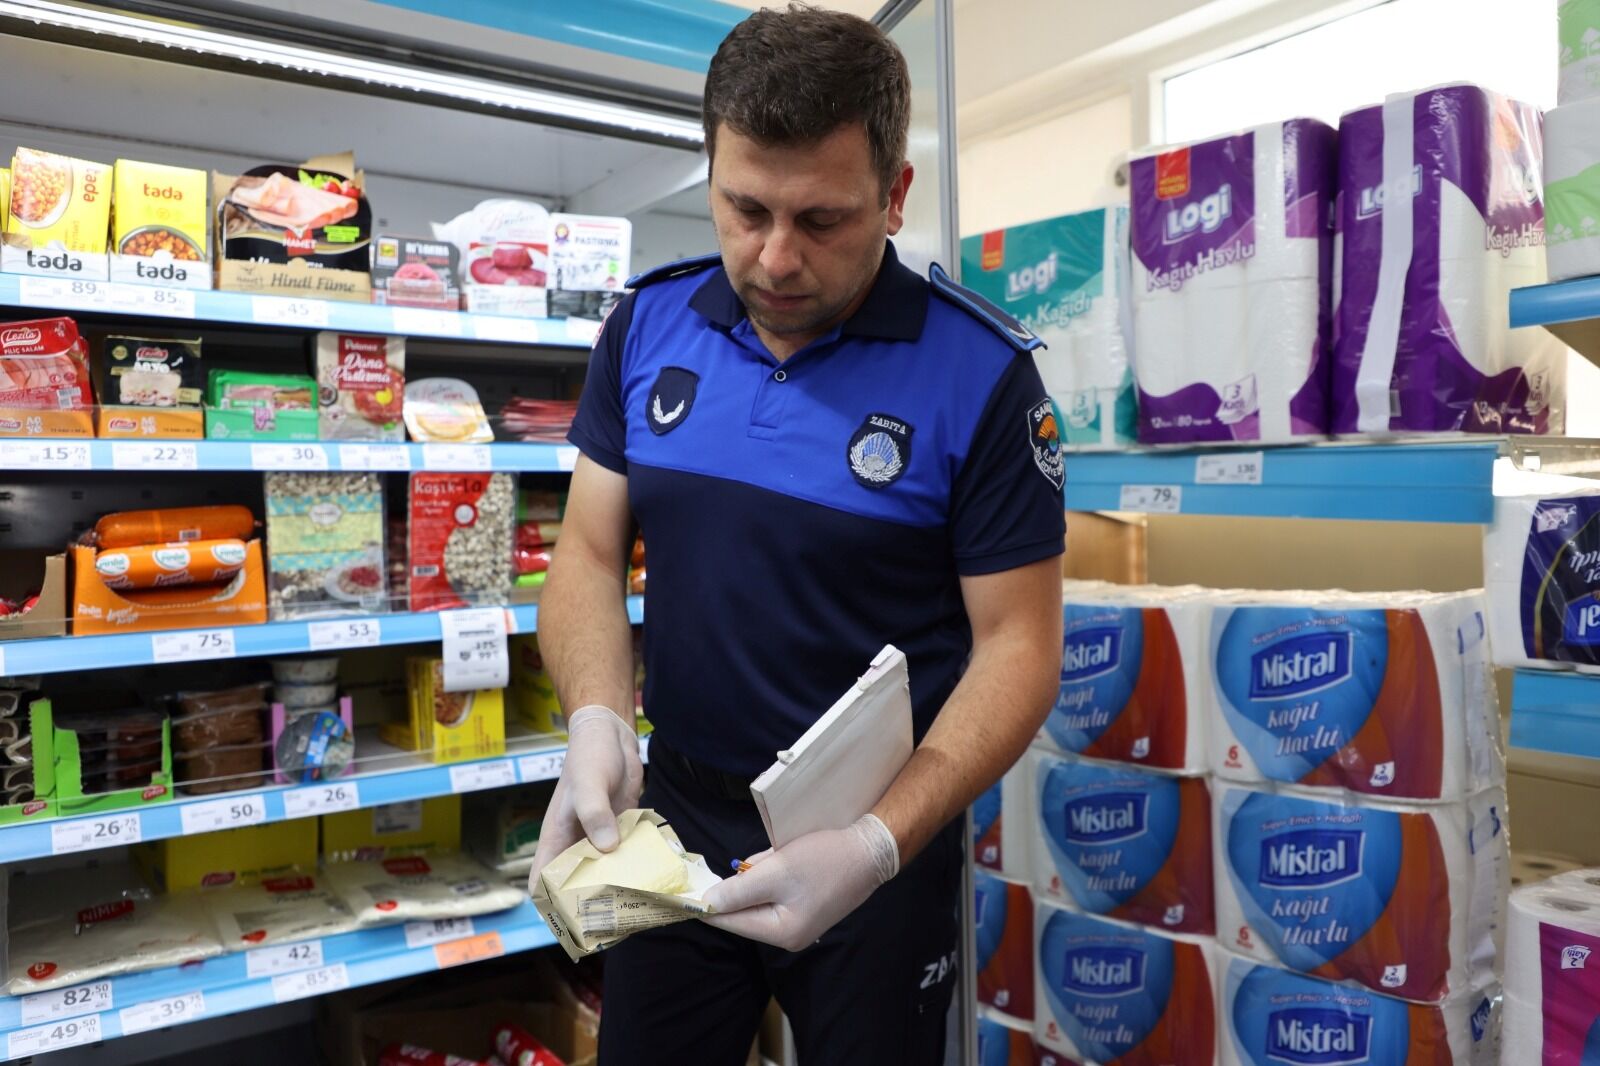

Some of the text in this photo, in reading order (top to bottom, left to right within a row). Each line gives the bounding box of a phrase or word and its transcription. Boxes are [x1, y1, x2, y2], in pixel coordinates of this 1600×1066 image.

[83, 168, 100, 202] tada
[143, 183, 183, 200] tada
[1166, 183, 1232, 233] Logi
[1521, 223, 1546, 249] Hav
[27, 250, 82, 271] tada
[1147, 240, 1257, 292] Kağıt Havlu
[137, 262, 187, 281] tada
[1008, 252, 1058, 294] Logi
[72, 282, 97, 295] 89
[271, 273, 356, 293] Hindi Füme
[154, 290, 177, 304] 85
[288, 303, 309, 316] 45
[869, 415, 906, 435] ZABITA
[293, 447, 314, 460] 30
[1153, 488, 1172, 502] 79
[350, 624, 370, 637] 53
[200, 633, 223, 648] 75
[1261, 641, 1337, 688] Mistral
[1228, 745, 1239, 761] 6
[324, 787, 346, 803] 26
[231, 803, 253, 819] 50
[1071, 801, 1134, 834] Mistral
[1269, 839, 1346, 877] Mistral
[1239, 926, 1249, 941] 6
[289, 945, 311, 960] 42
[1071, 955, 1132, 985] Mistral
[1569, 957, 1578, 967] 2
[1277, 1018, 1355, 1053] Mistral
